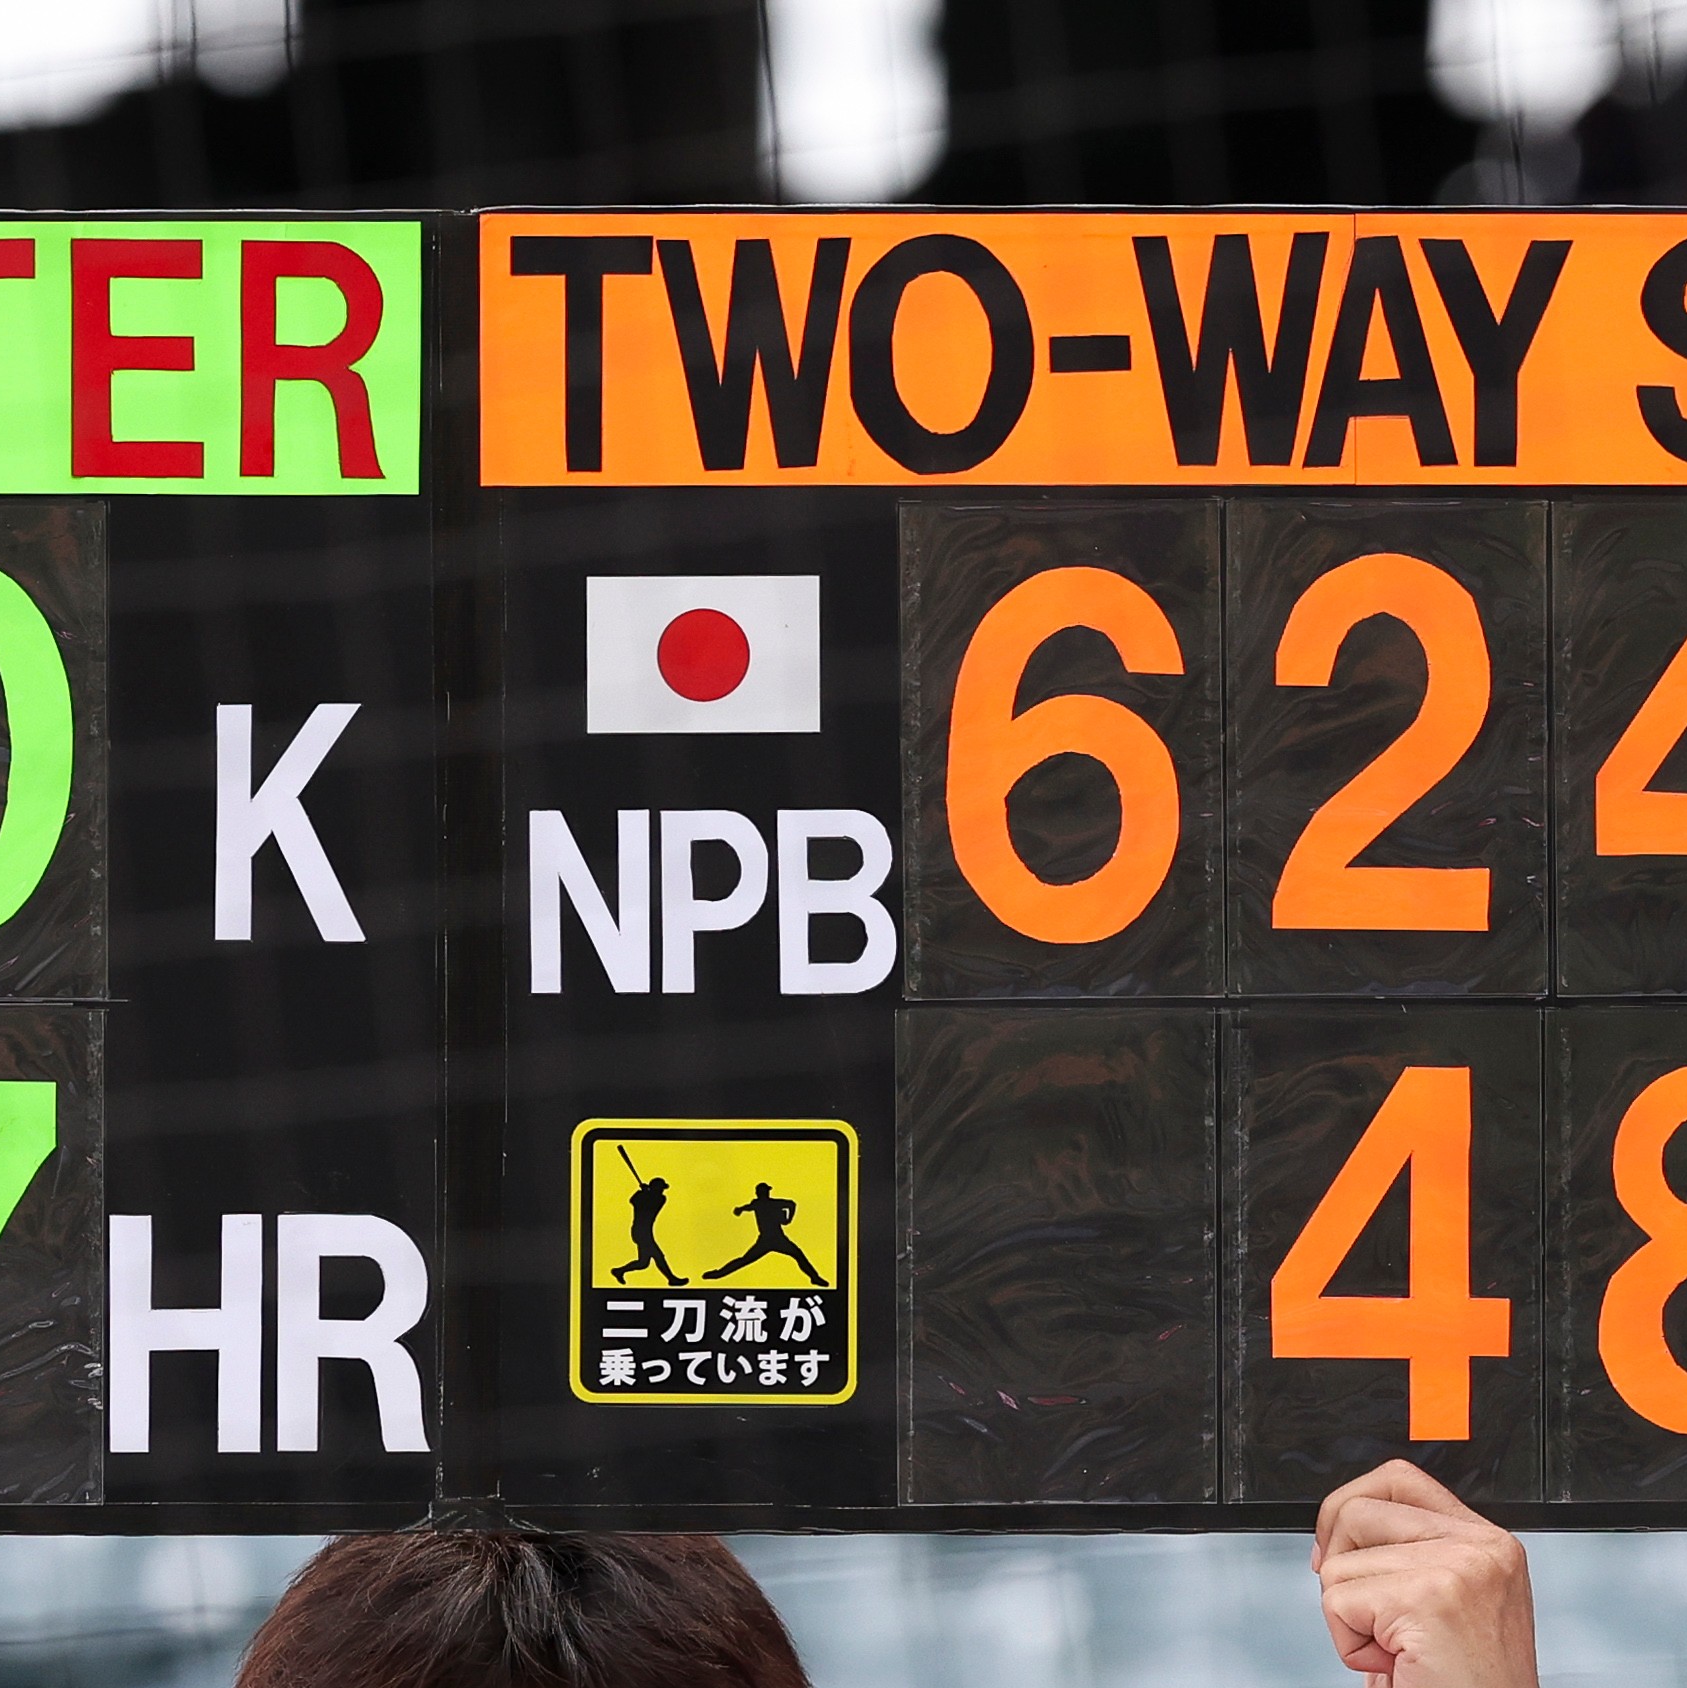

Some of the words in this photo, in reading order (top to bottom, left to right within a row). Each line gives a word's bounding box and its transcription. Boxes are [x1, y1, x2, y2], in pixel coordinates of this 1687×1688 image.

[510, 231, 1573, 475] TWO-WAY
[215, 702, 366, 943] K
[528, 808, 898, 996] NPB
[108, 1213, 433, 1454] HR
[598, 1347, 831, 1387] 乗っています
[601, 1294, 827, 1343] 二刀流が
